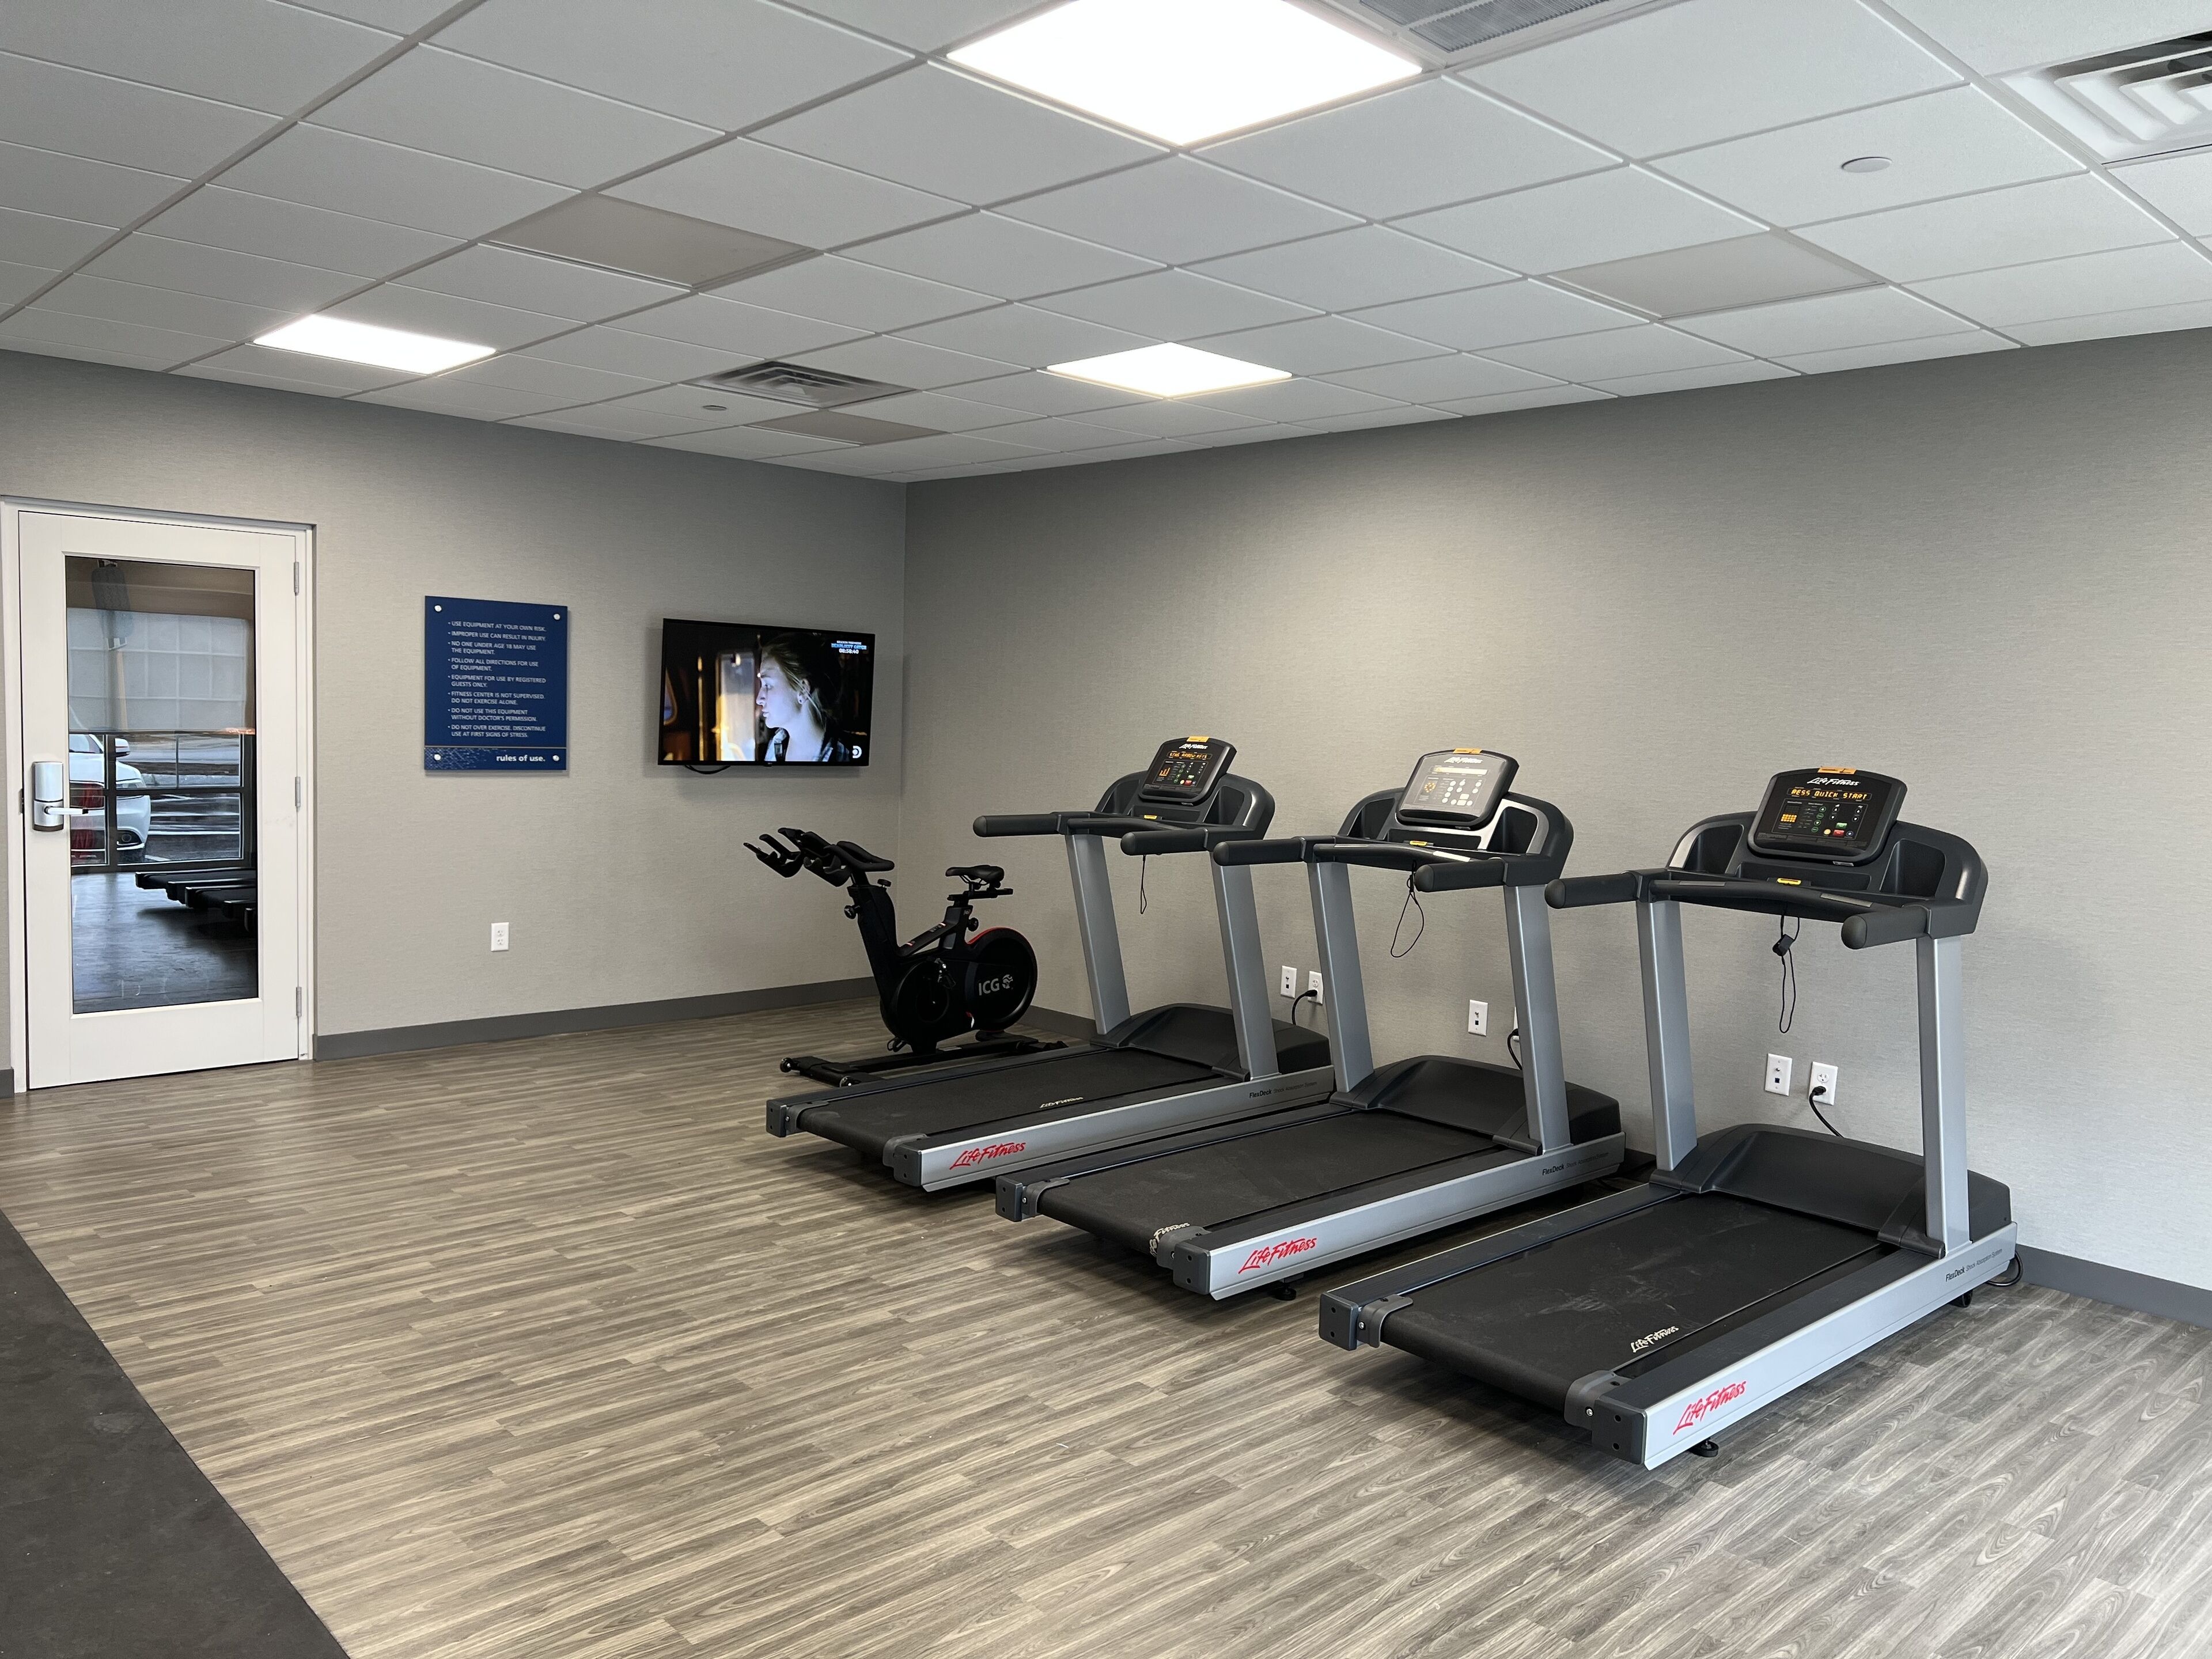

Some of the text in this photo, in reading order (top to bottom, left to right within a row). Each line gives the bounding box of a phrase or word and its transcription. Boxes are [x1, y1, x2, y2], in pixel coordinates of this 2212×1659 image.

[979, 978, 999, 995] ICG
[1249, 1089, 1272, 1099] FlexDeck
[1542, 1164, 1565, 1175] FlexDeck
[1945, 1266, 1965, 1282] FlexDeck
